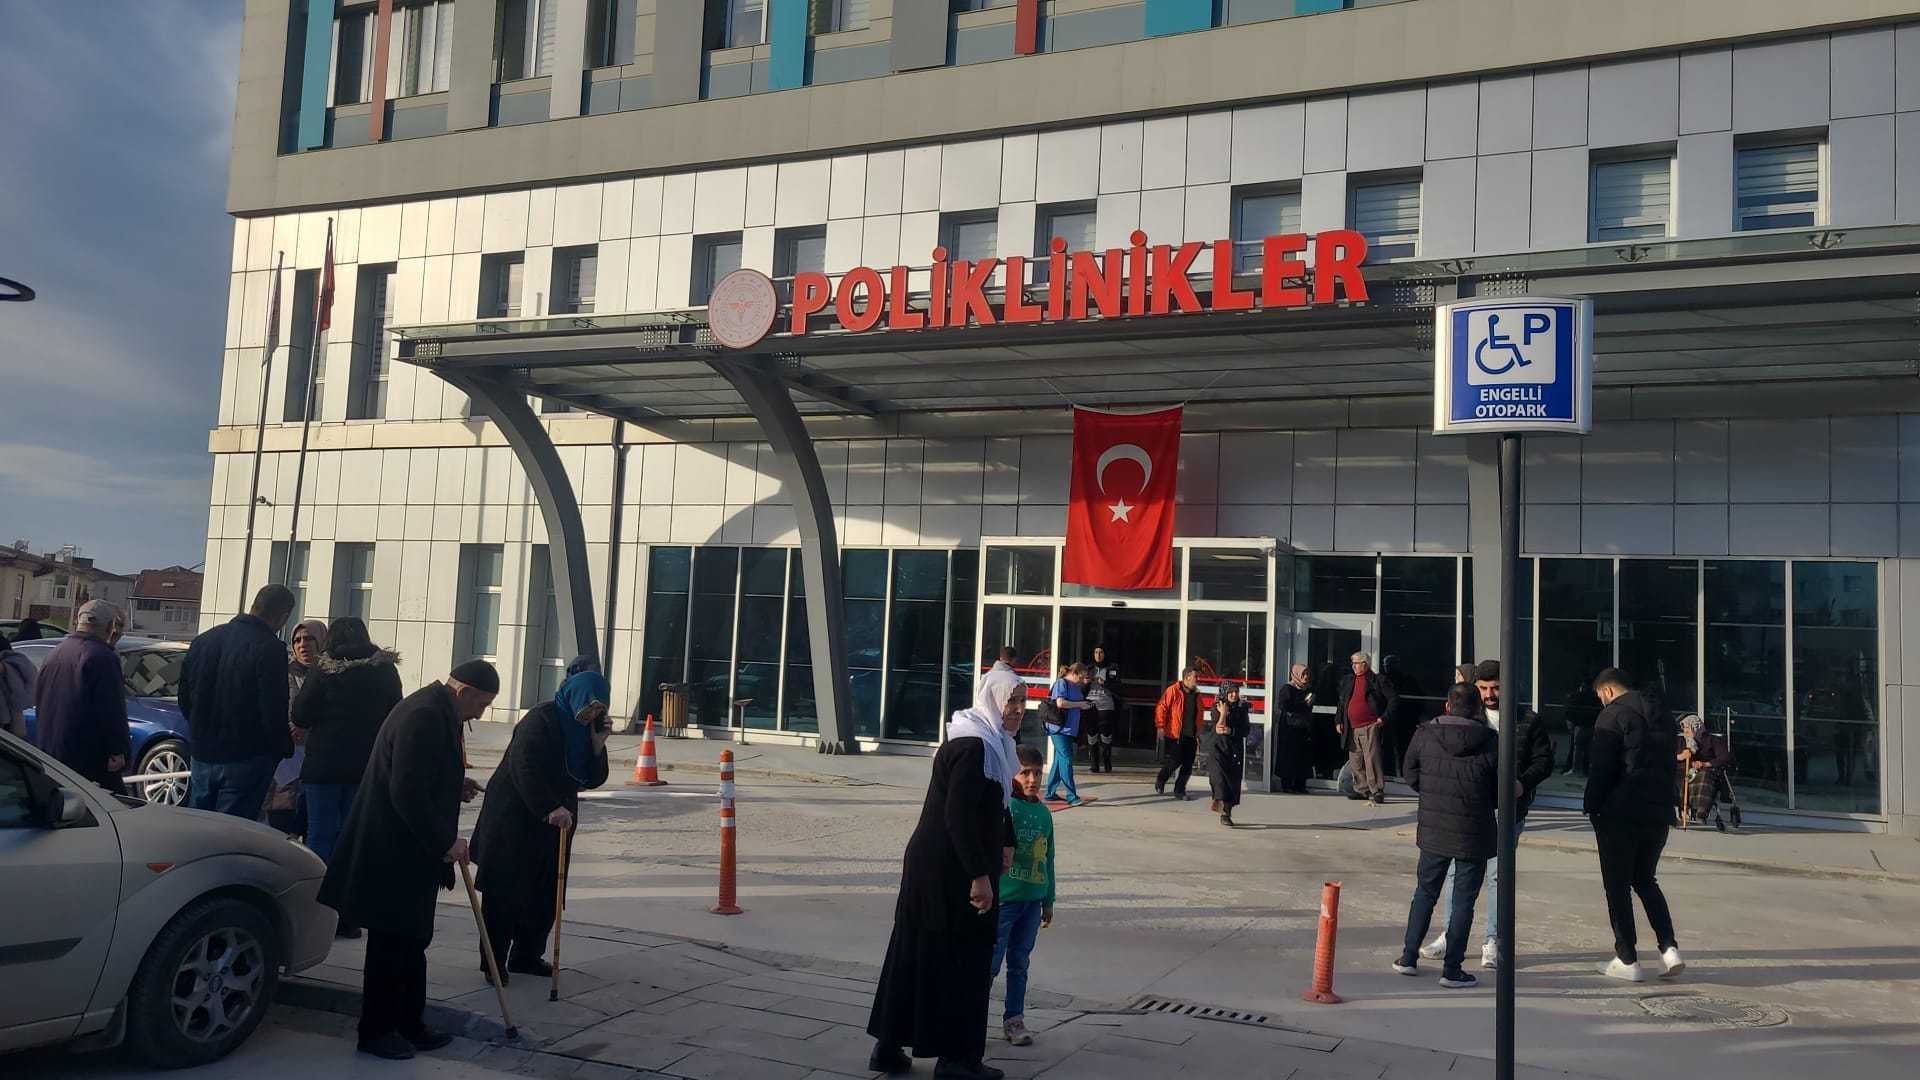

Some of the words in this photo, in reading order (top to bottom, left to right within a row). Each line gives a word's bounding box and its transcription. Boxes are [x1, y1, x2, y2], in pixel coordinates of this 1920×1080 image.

[791, 230, 1369, 336] POLİKLİNİKLER
[1524, 314, 1550, 345] P
[1481, 386, 1541, 401] ENGELLİ
[1475, 404, 1547, 417] OTOPARK
